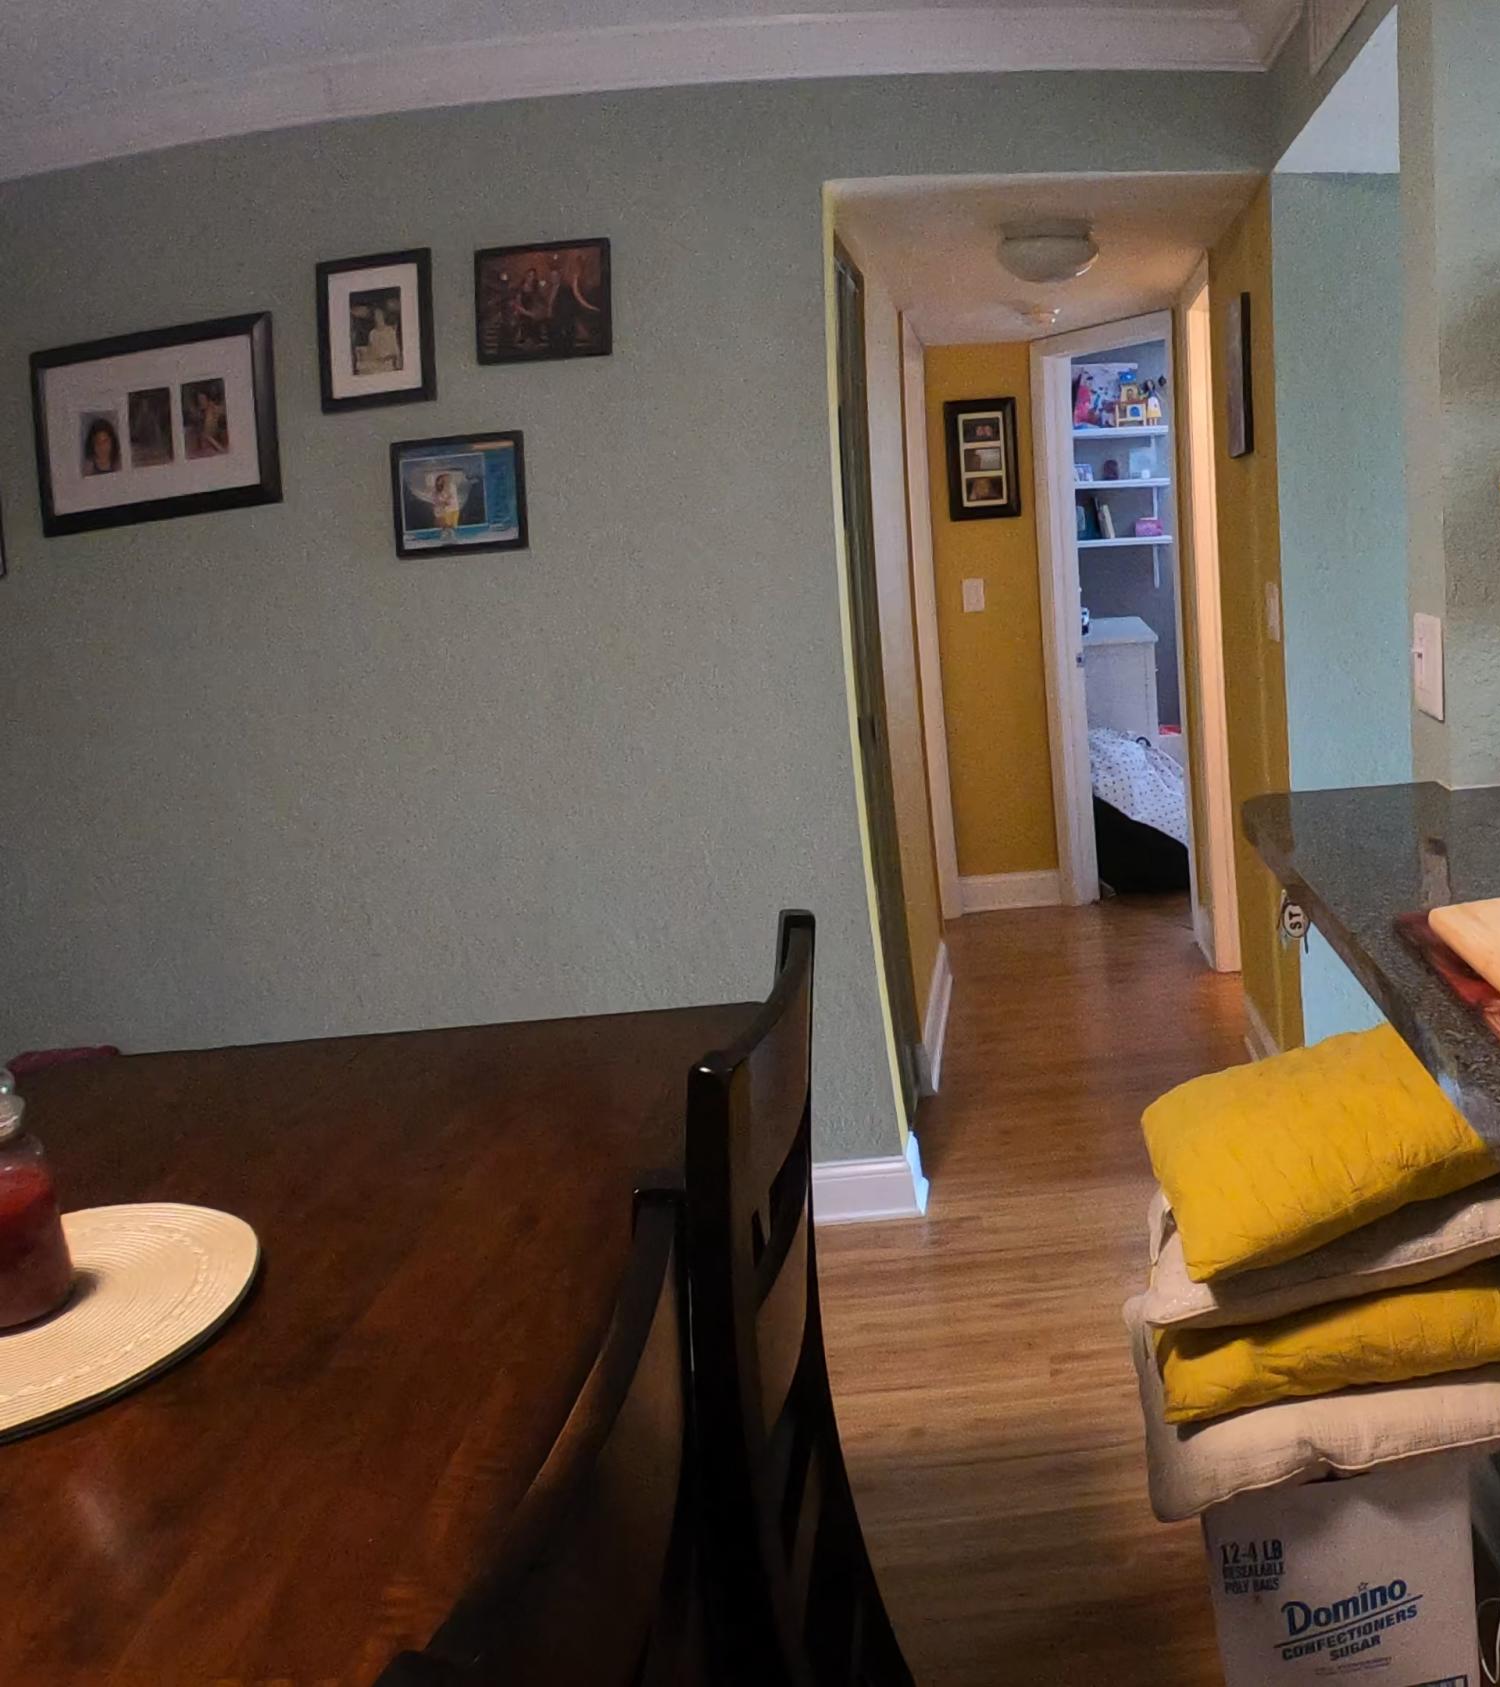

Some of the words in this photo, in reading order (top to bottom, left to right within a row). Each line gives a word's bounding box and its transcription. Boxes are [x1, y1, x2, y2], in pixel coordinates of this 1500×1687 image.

[1263, 1539, 1283, 1561] LB
[1281, 1579, 1407, 1636] Domino
[1282, 1605, 1418, 1661] CONFECTIONERS
[1329, 1635, 1382, 1661] SUGAR
